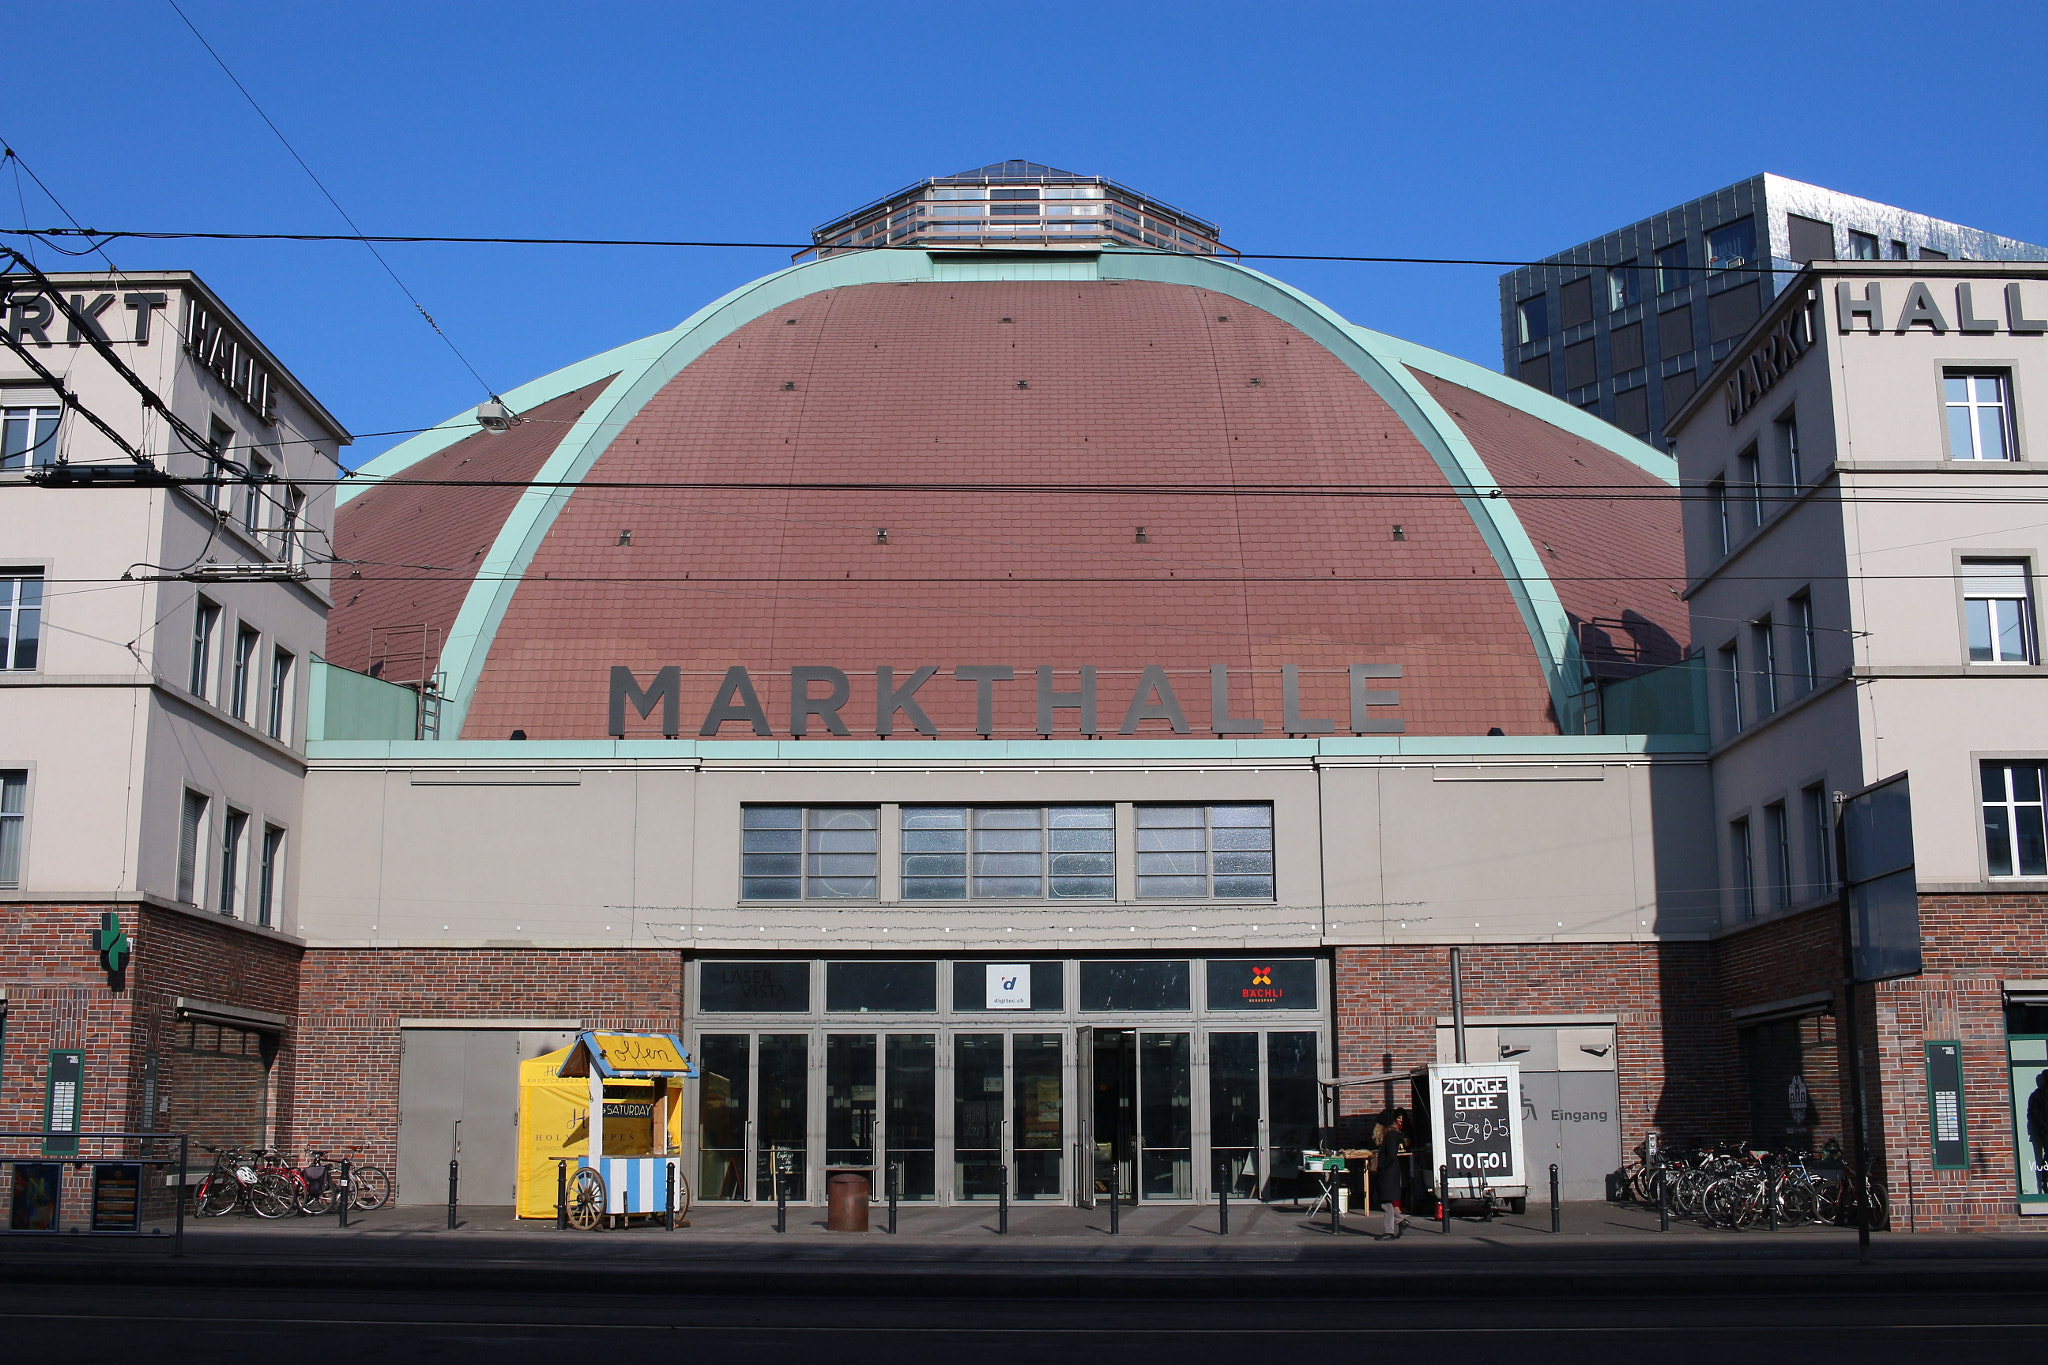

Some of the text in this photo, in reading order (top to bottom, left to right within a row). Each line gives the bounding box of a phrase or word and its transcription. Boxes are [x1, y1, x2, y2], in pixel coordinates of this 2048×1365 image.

[1836, 281, 2048, 333] HALL
[183, 300, 280, 428] HALLE
[1725, 289, 1818, 427] MARKT
[608, 664, 1406, 737] MARKTHALLE
[722, 969, 773, 984] LASER
[741, 984, 787, 998] VISTA
[1442, 1077, 1508, 1095] ZMORGE
[606, 1104, 653, 1116] SATURDAY
[1454, 1094, 1499, 1111] EGGE
[1551, 1109, 1608, 1123] Eingang
[1451, 1153, 1475, 1169] TO
